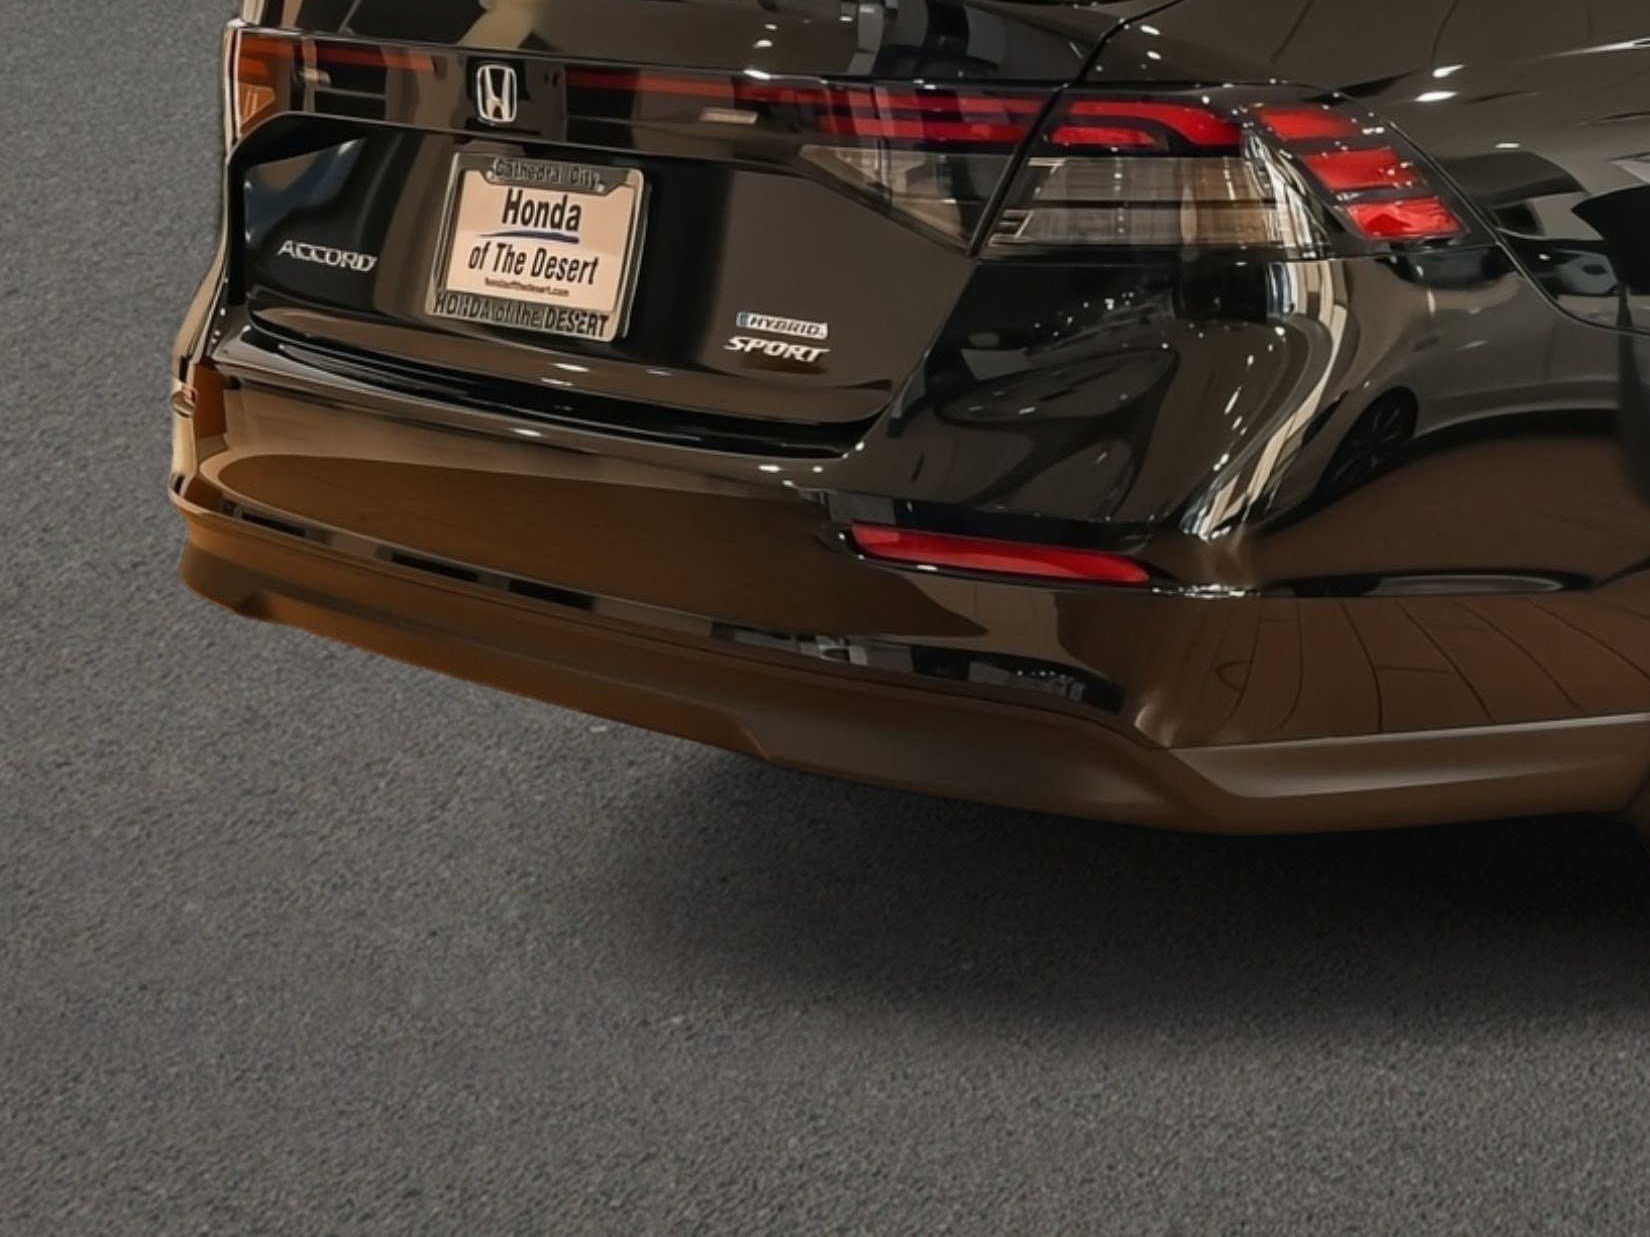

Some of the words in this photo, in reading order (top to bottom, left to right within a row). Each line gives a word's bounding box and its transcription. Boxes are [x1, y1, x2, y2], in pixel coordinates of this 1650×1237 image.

[501, 187, 582, 232] Honda
[277, 240, 378, 272] ACCORD
[468, 240, 492, 269] of
[492, 242, 527, 275] The
[530, 247, 599, 285] Desert
[433, 291, 489, 319] HONDA
[544, 307, 610, 338] DESERT
[748, 314, 821, 337] HYBRID
[723, 335, 832, 363] SPORT
